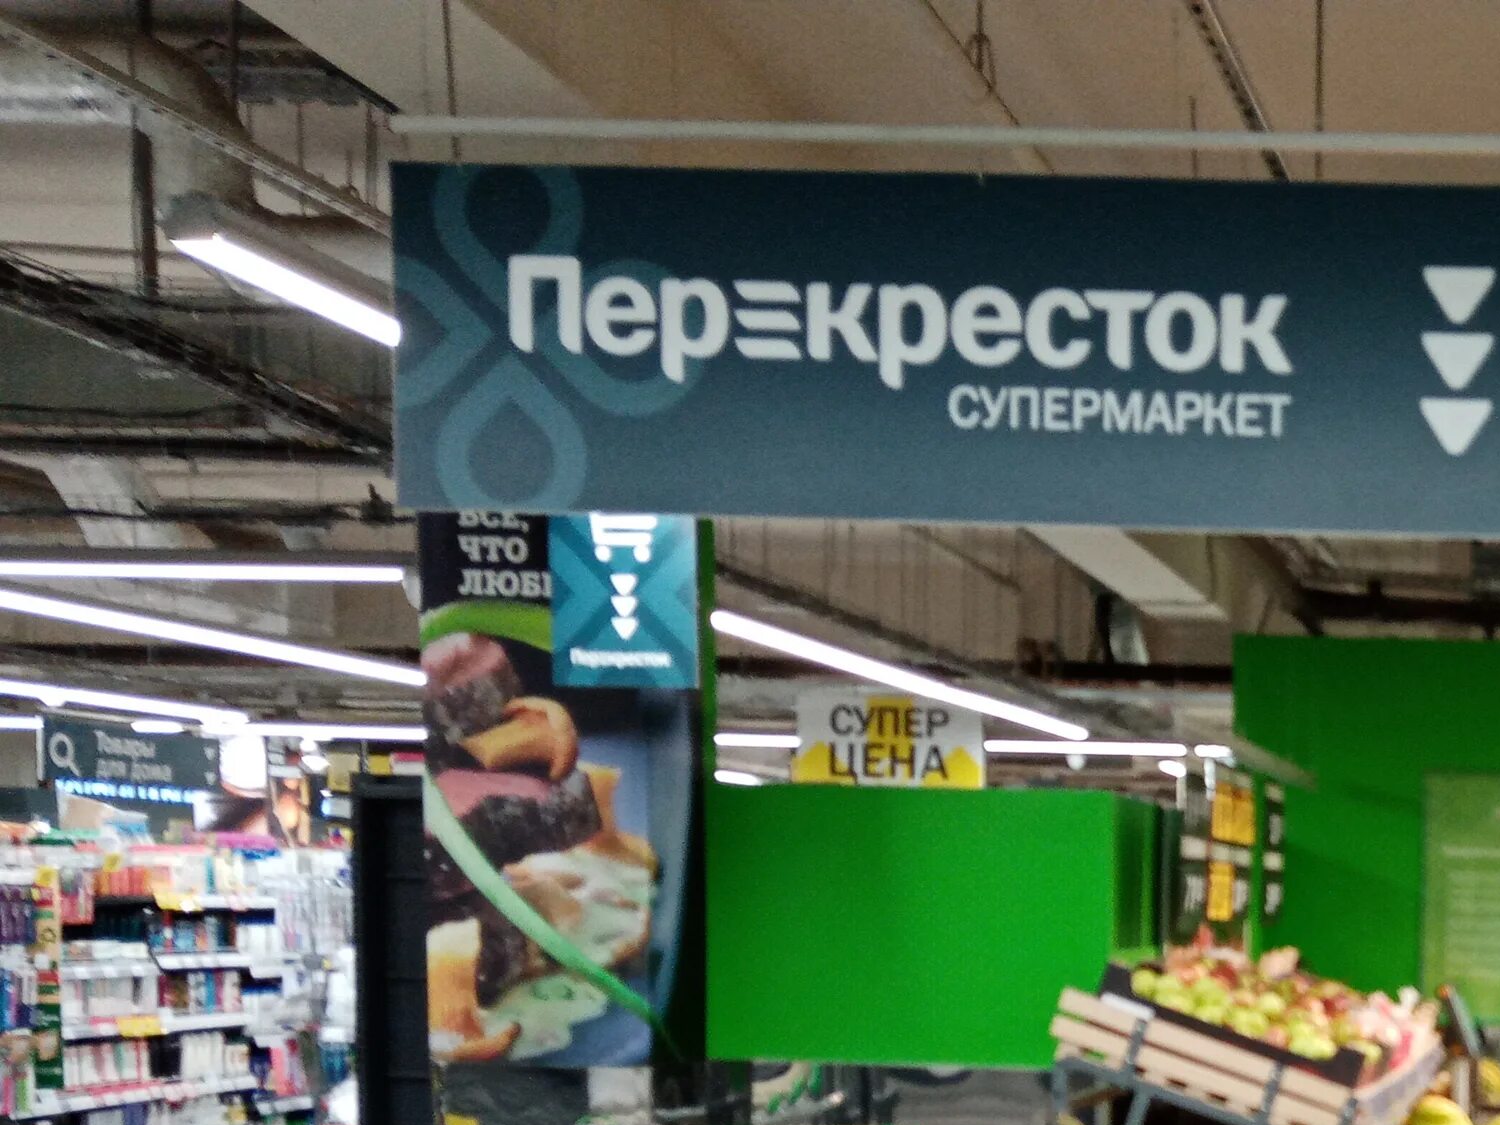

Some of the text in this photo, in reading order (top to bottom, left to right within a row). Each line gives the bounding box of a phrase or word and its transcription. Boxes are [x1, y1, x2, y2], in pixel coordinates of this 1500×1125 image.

[507, 254, 1294, 391] Перекресток
[947, 384, 1292, 439] СУПЕРМАРКЕТ
[457, 534, 529, 564] ЧТО
[829, 703, 950, 737] СУПЕР
[828, 741, 949, 785] ЦЕНА
